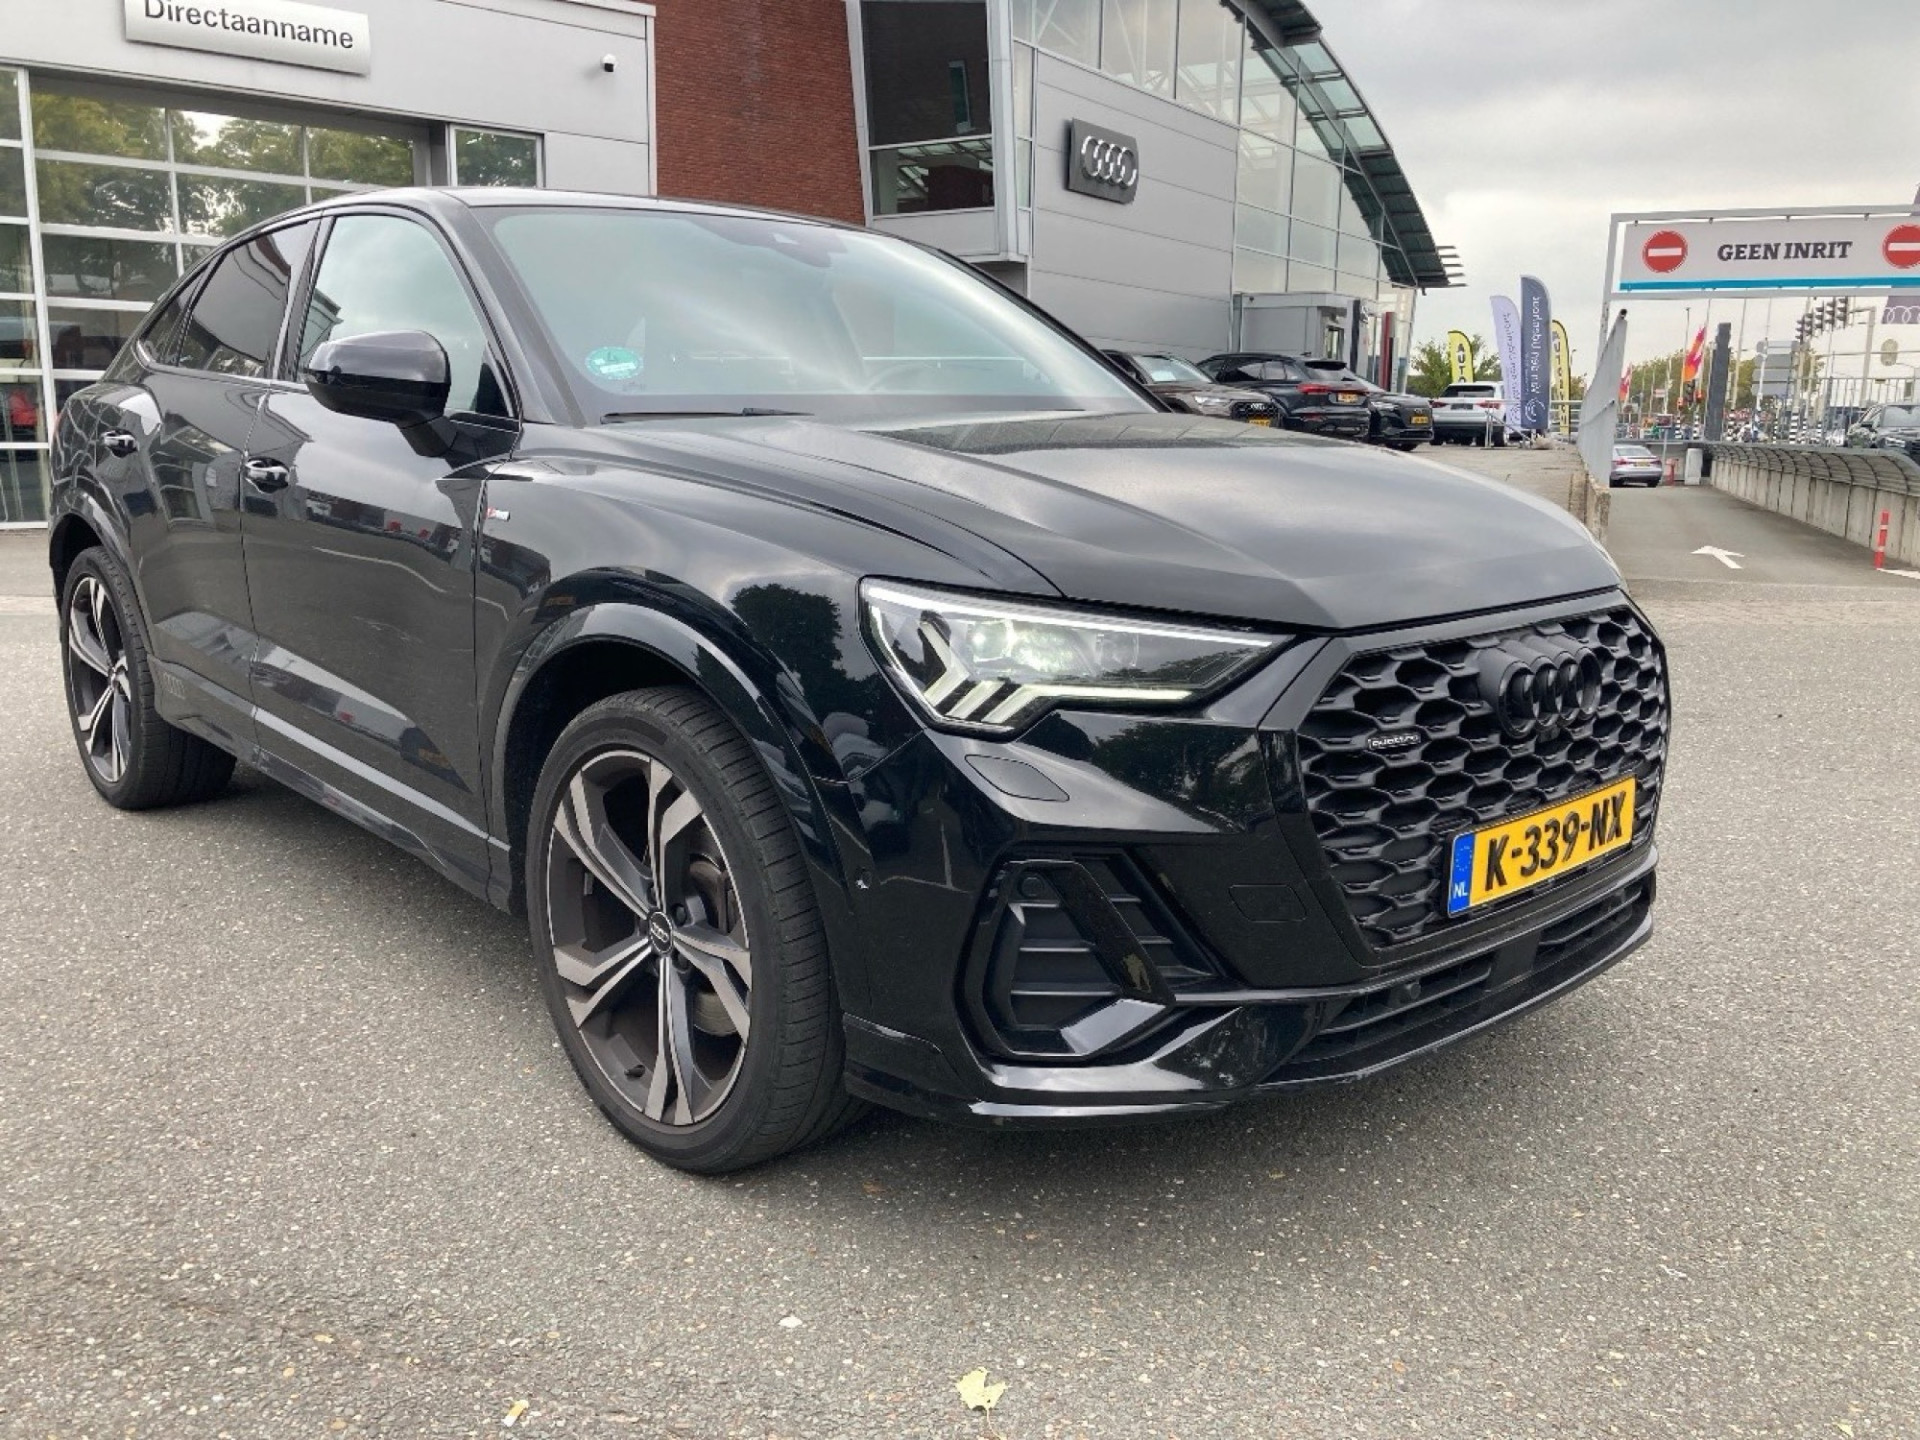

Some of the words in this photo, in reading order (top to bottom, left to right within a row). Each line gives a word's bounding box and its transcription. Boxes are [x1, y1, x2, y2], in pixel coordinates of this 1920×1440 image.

[144, 0, 354, 49] Directaanname
[1717, 242, 1781, 261] GEEN
[1783, 241, 1853, 260] INRIT
[1484, 790, 1627, 892] K-339-NX
[1452, 881, 1468, 899] NL
